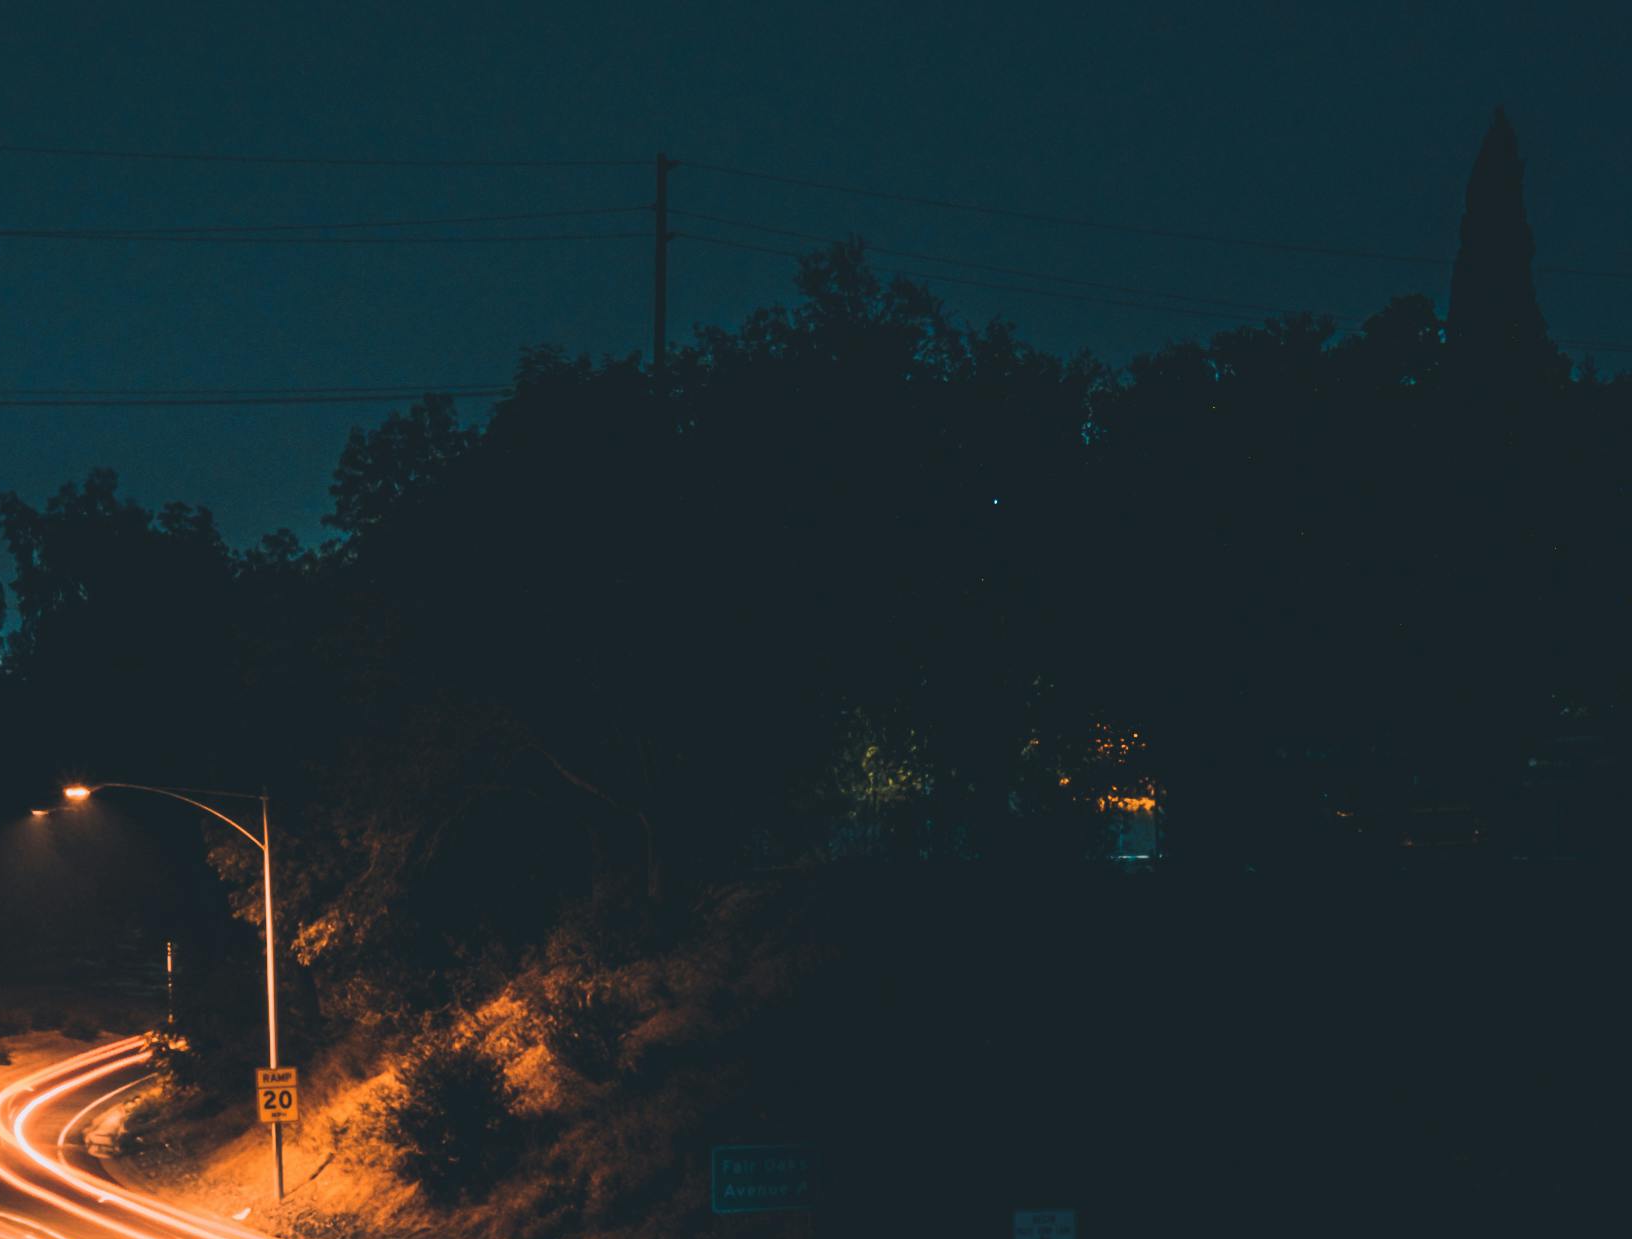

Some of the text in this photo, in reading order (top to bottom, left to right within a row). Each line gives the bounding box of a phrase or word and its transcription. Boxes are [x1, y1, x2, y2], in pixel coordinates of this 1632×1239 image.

[263, 1072, 292, 1083] RAMP
[263, 1090, 292, 1109] 20
[721, 1159, 756, 1175] Fair
[723, 1183, 789, 1199] Avenue
